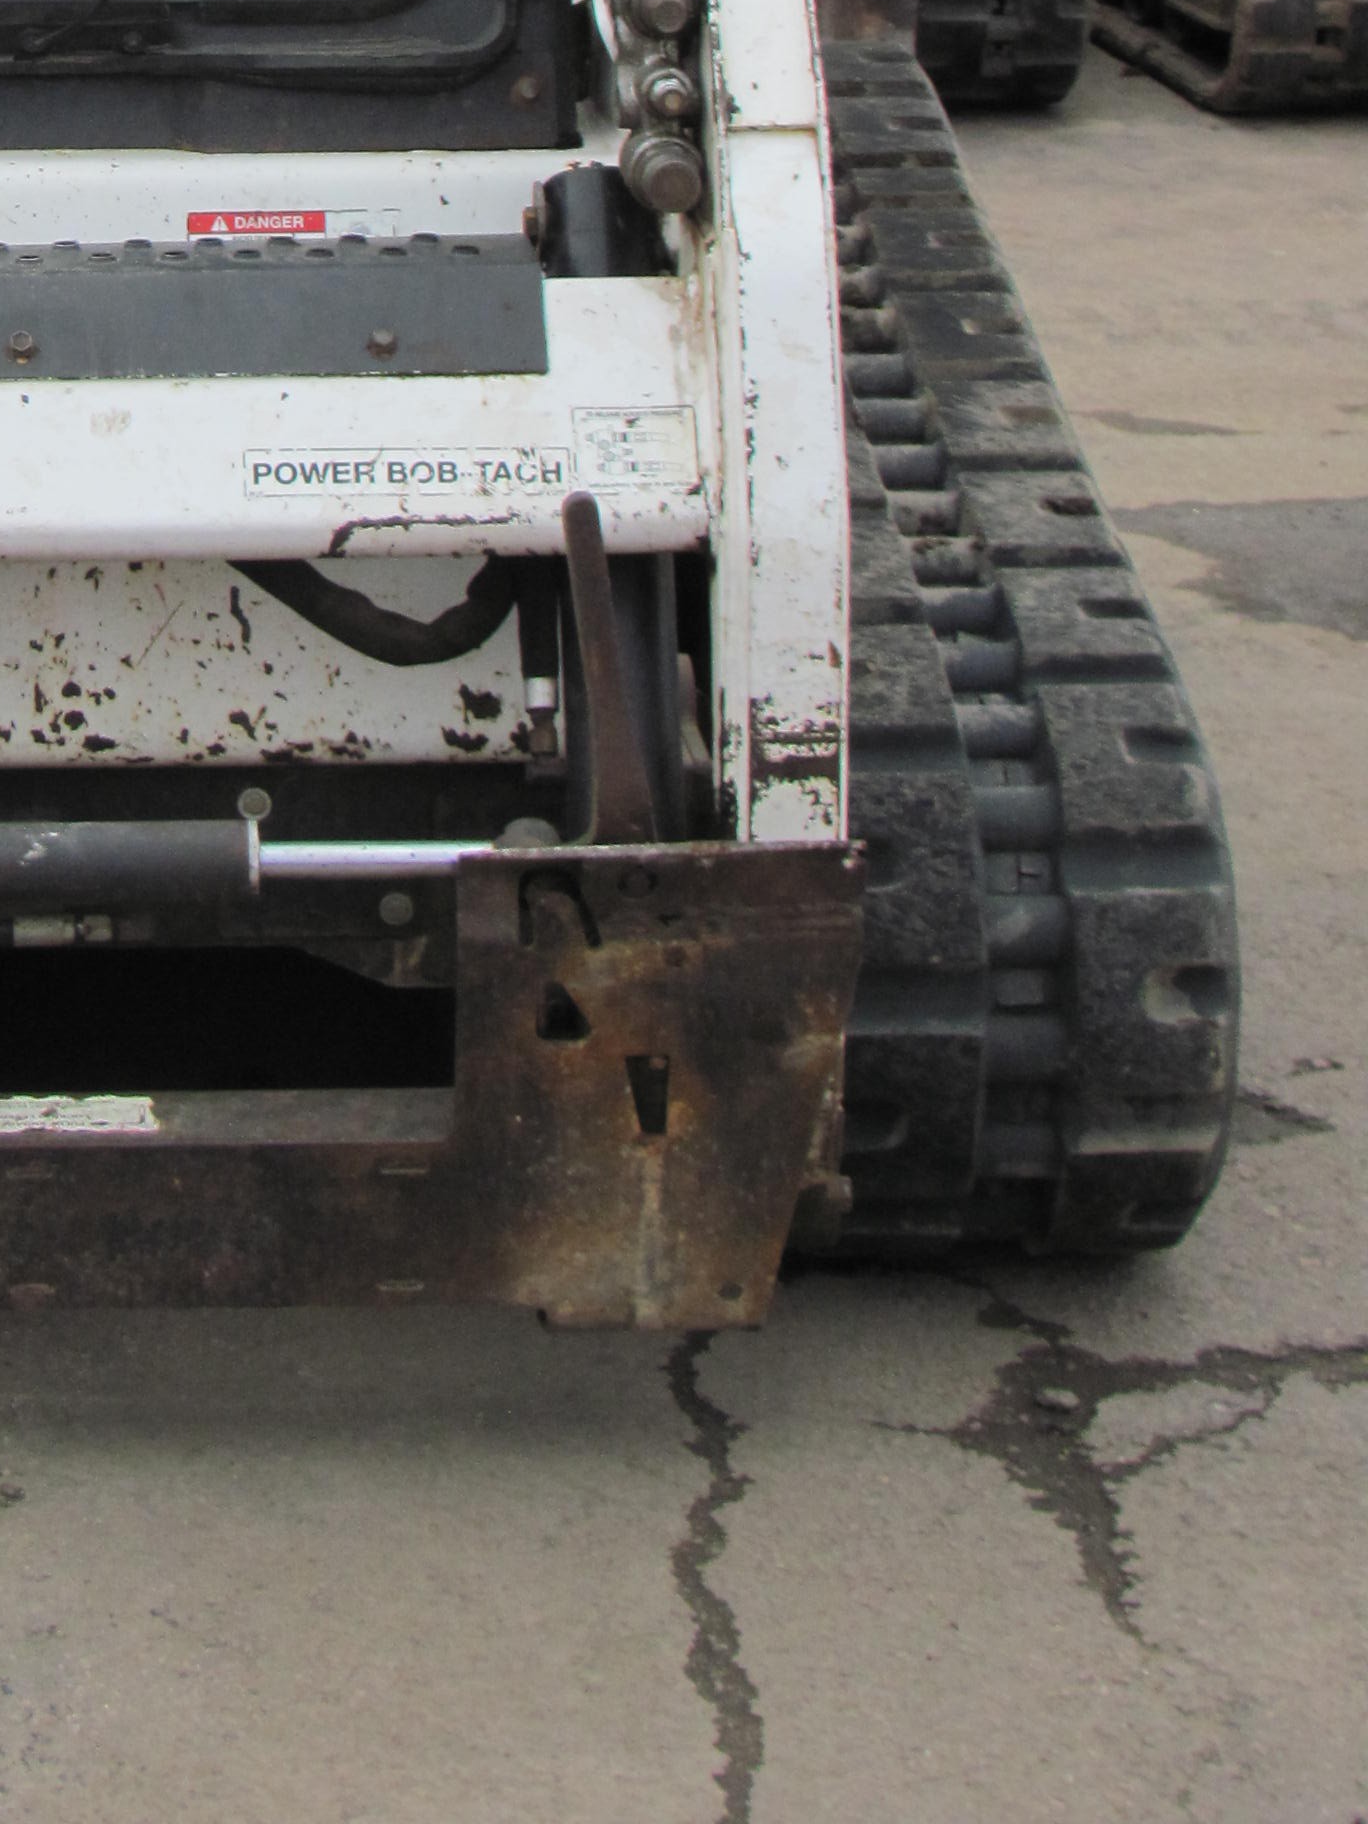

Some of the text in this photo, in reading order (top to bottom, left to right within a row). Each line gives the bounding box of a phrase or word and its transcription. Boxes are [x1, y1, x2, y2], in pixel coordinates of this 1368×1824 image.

[234, 215, 305, 230] DANGER
[253, 460, 563, 485] POWER BOB-TACH
